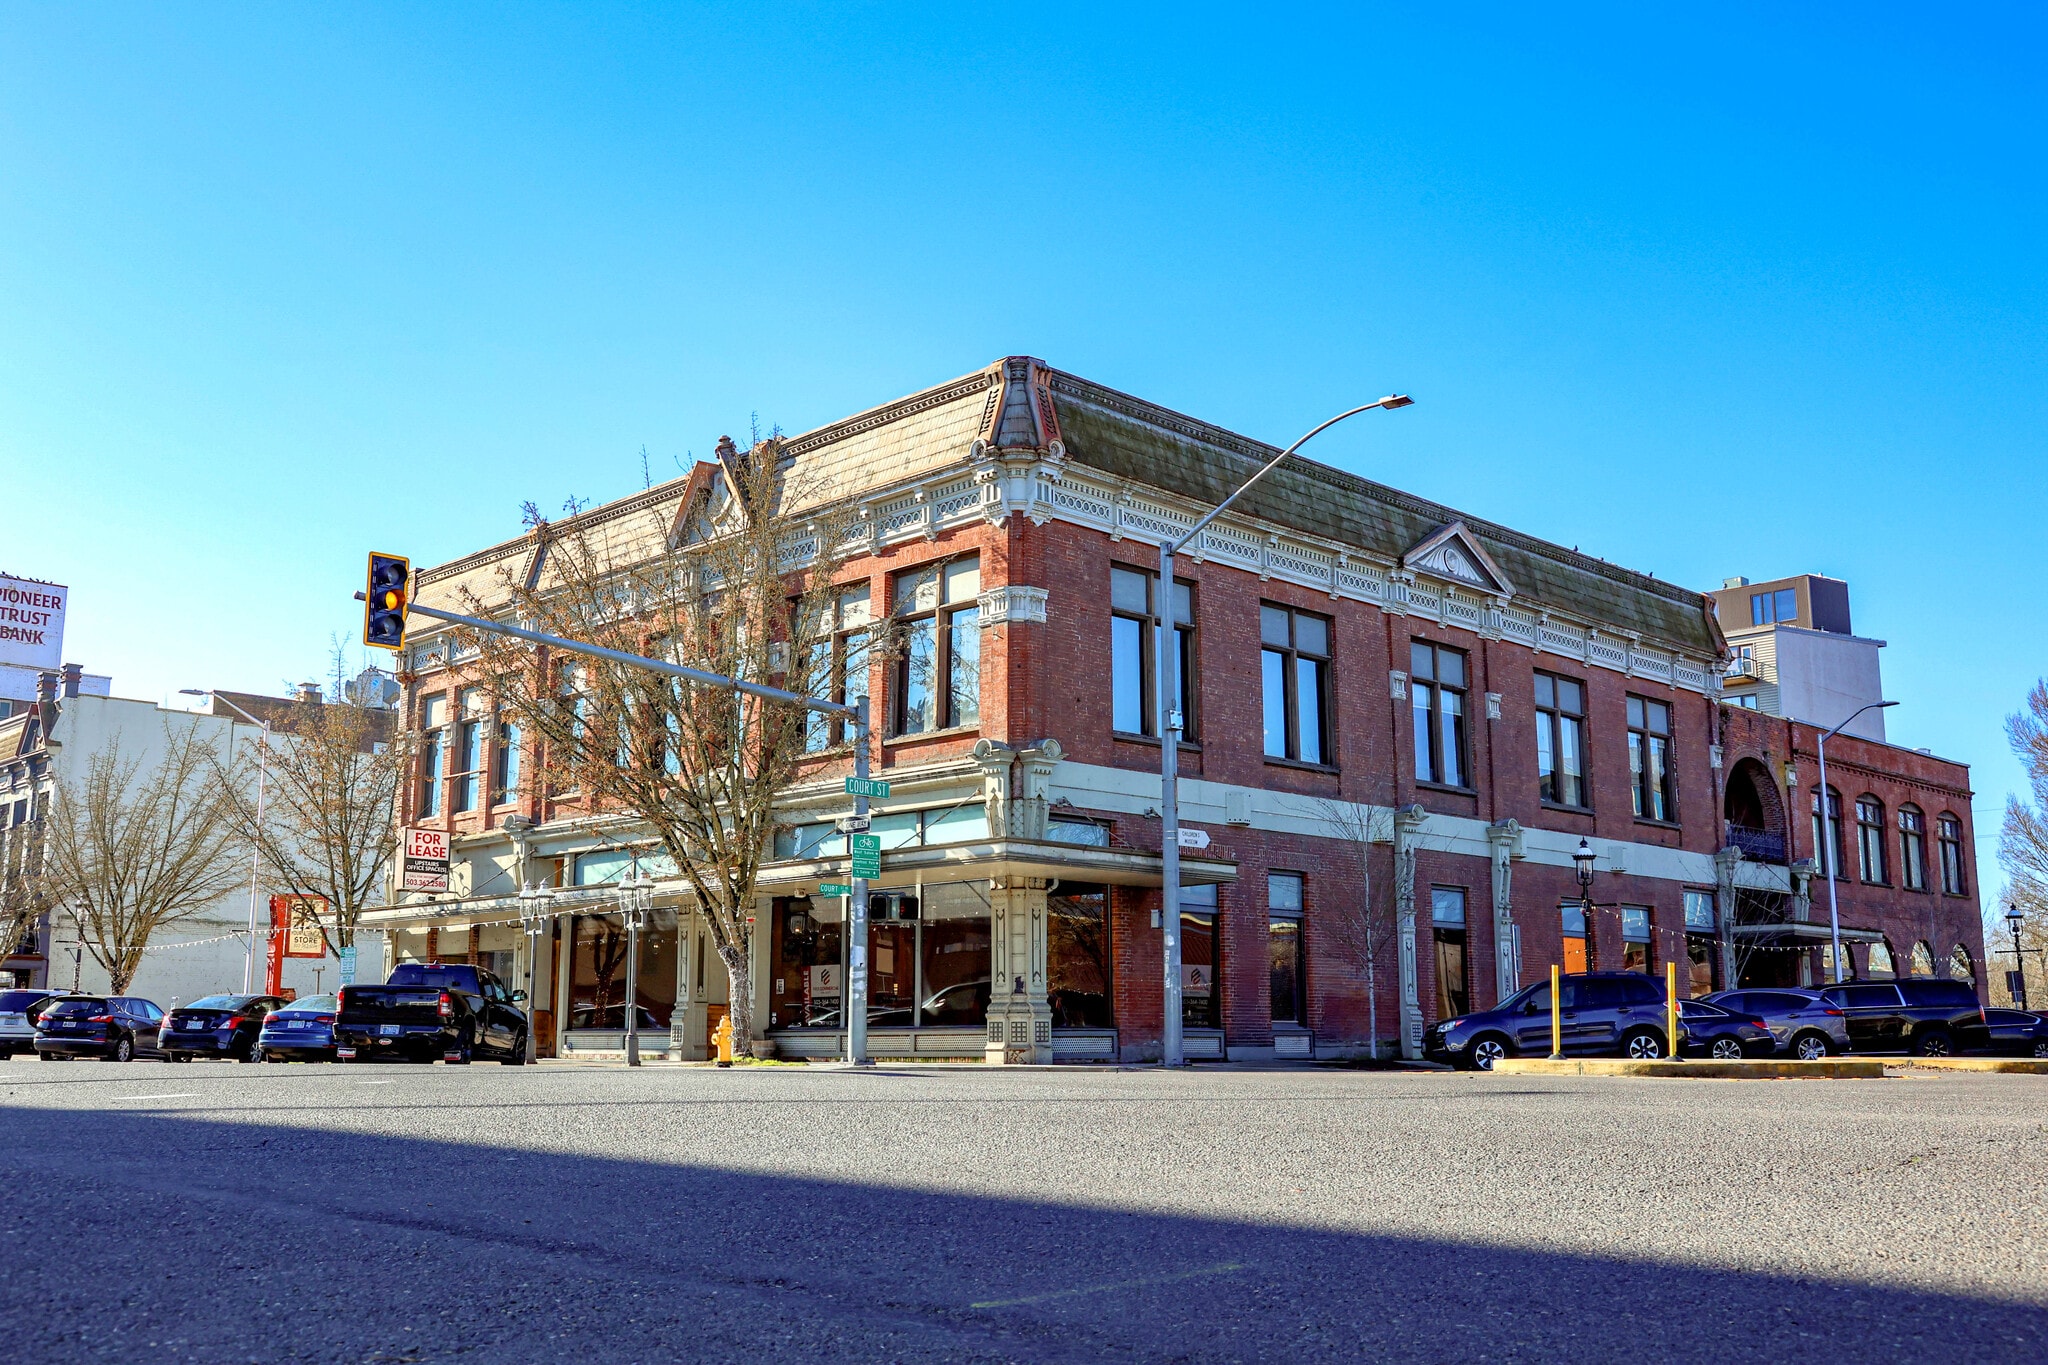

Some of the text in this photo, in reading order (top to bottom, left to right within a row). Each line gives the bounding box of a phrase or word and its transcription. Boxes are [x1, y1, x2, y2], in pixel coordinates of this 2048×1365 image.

[0, 606, 51, 626] TRUST
[0, 625, 45, 645] BANK
[849, 779, 886, 796] COURT ST
[415, 832, 441, 845] FOR
[408, 845, 447, 858] LEASE
[820, 884, 838, 893] COURT
[294, 936, 318, 944] STORE
[803, 970, 811, 1023] AVAILABLE
